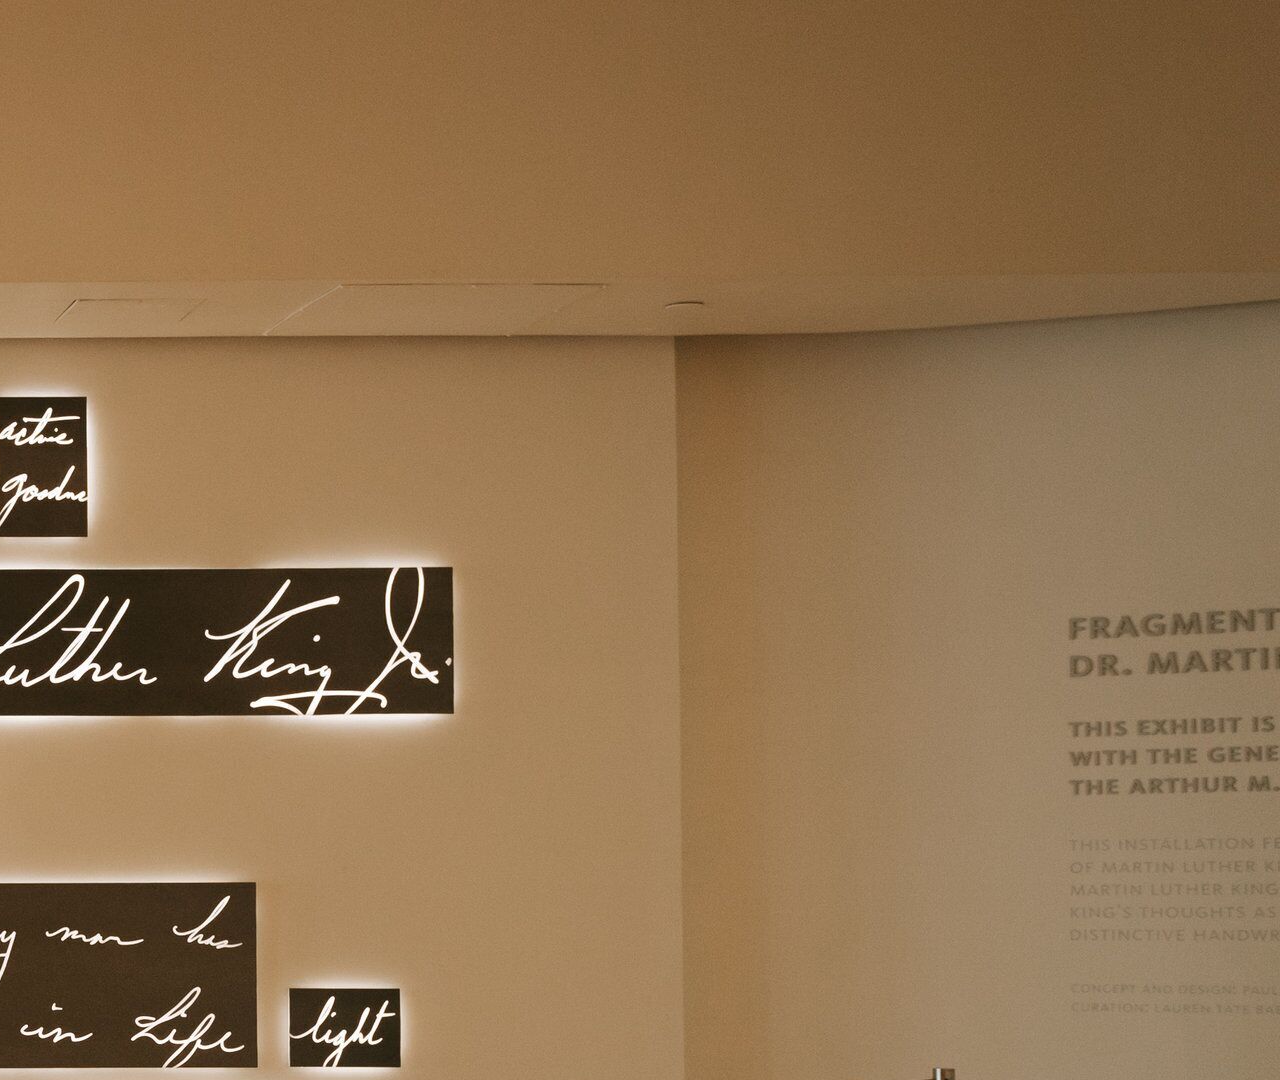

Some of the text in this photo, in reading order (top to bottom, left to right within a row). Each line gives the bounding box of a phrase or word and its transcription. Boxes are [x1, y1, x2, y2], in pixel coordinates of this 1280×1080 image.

[1068, 608, 1280, 640] FRAGMENT
[204, 578, 360, 715] King
[1069, 654, 1133, 678] DR.
[1068, 715, 1276, 738] THIS EXHIBIT IS
[1068, 745, 1280, 767] WITH THE GENE
[1068, 774, 1280, 796] THE ARTHUR M.
[1069, 837, 1255, 852] THIS INSTALLATION
[1069, 859, 1257, 874] OF MARTIN LUTHER
[1069, 881, 1280, 897] MARTIN LUTHER KING
[45, 925, 144, 947] man
[172, 895, 244, 950] has
[1140, 905, 1247, 919] THOUGHTS
[1253, 905, 1278, 919] AS
[1069, 928, 1186, 943] DISTINCTIVE
[20, 1003, 93, 1043] in
[130, 986, 245, 1069] Life
[290, 996, 397, 1067] light
